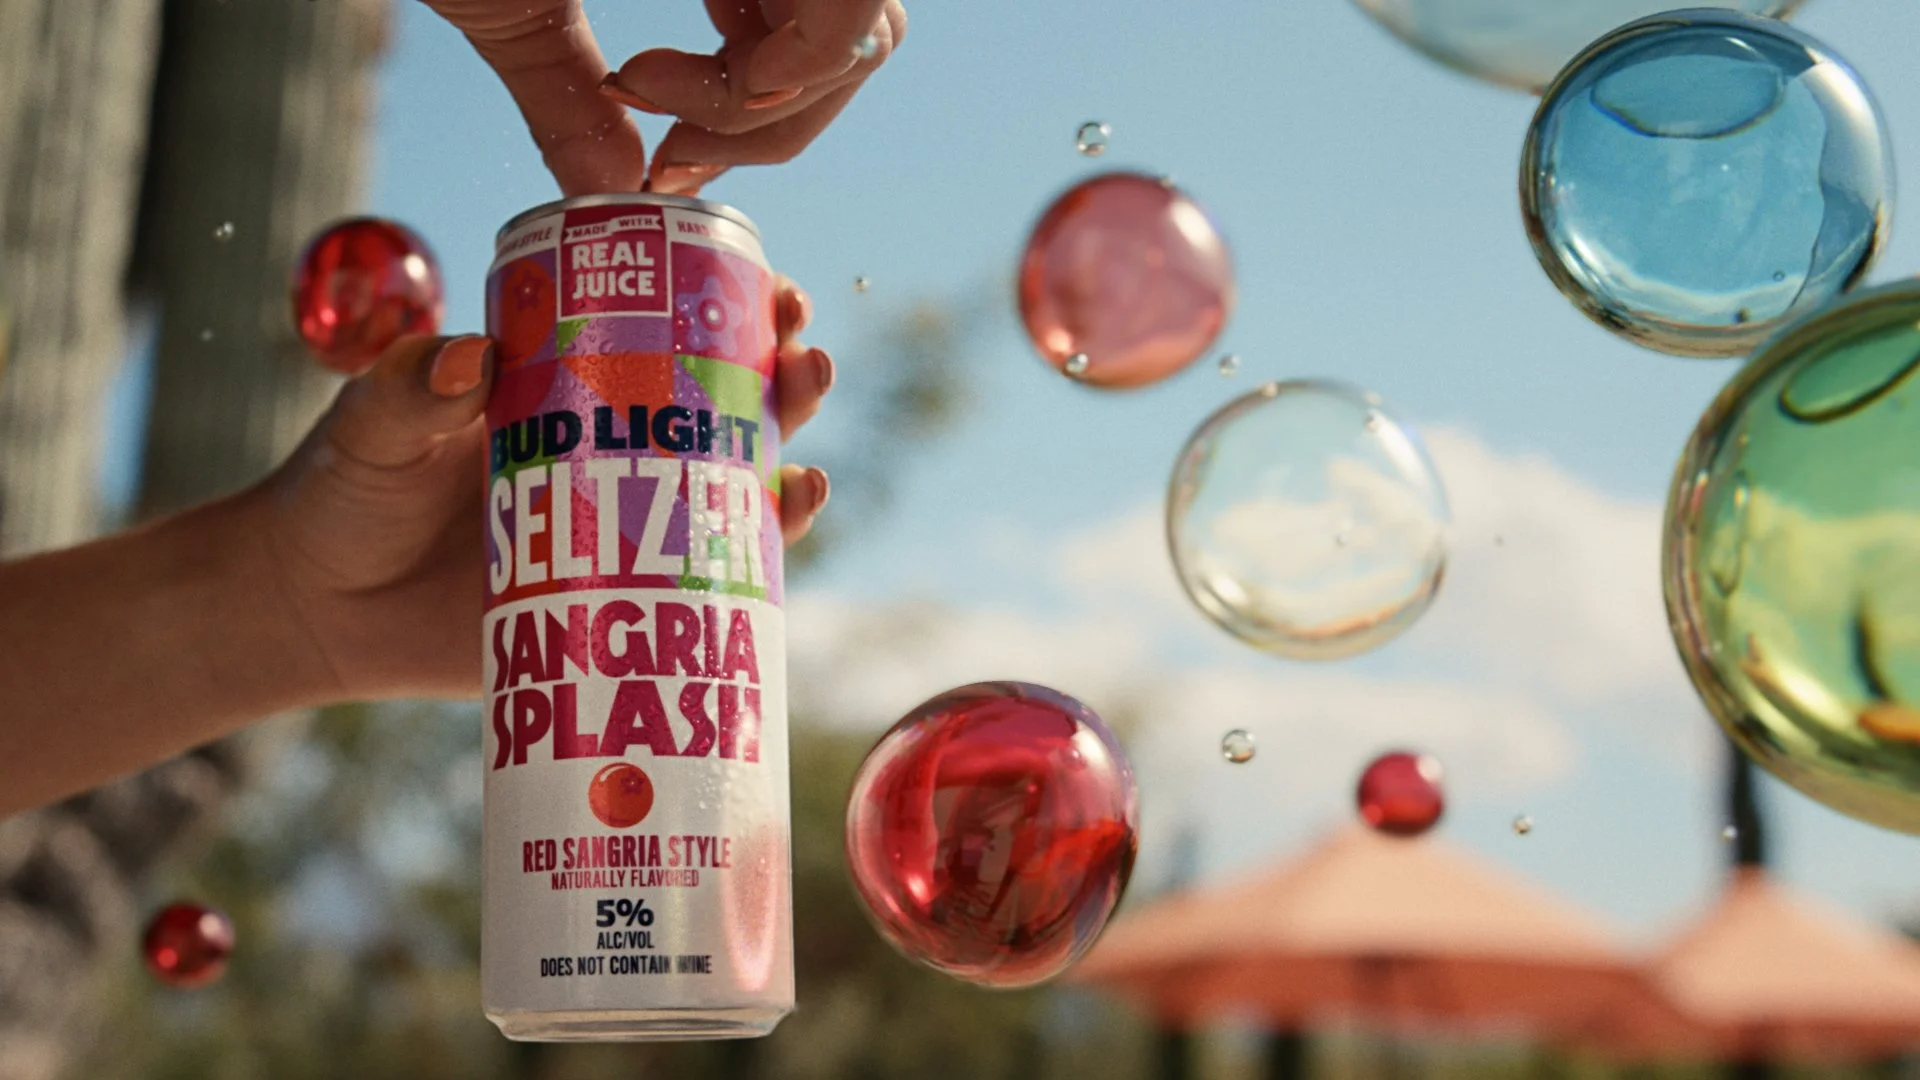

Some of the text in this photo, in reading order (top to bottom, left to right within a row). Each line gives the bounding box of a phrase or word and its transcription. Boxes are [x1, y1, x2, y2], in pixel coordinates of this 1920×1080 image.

[573, 216, 654, 238] MADE WITH
[572, 241, 655, 270] REAL
[572, 271, 655, 299] JUICE
[490, 405, 759, 471] BUD LIGHT
[490, 457, 764, 595] SELTZER
[493, 600, 761, 692] SANGRIA
[493, 680, 761, 770] SPLASH
[523, 835, 731, 873] RED SANGRIA STYLE
[551, 870, 626, 890] NATURALLY
[596, 899, 654, 927] 5%
[597, 931, 654, 950] ALC/VOL
[541, 957, 572, 977] DOES
[577, 956, 604, 976] NOT
[610, 955, 671, 975] CONTAIN
